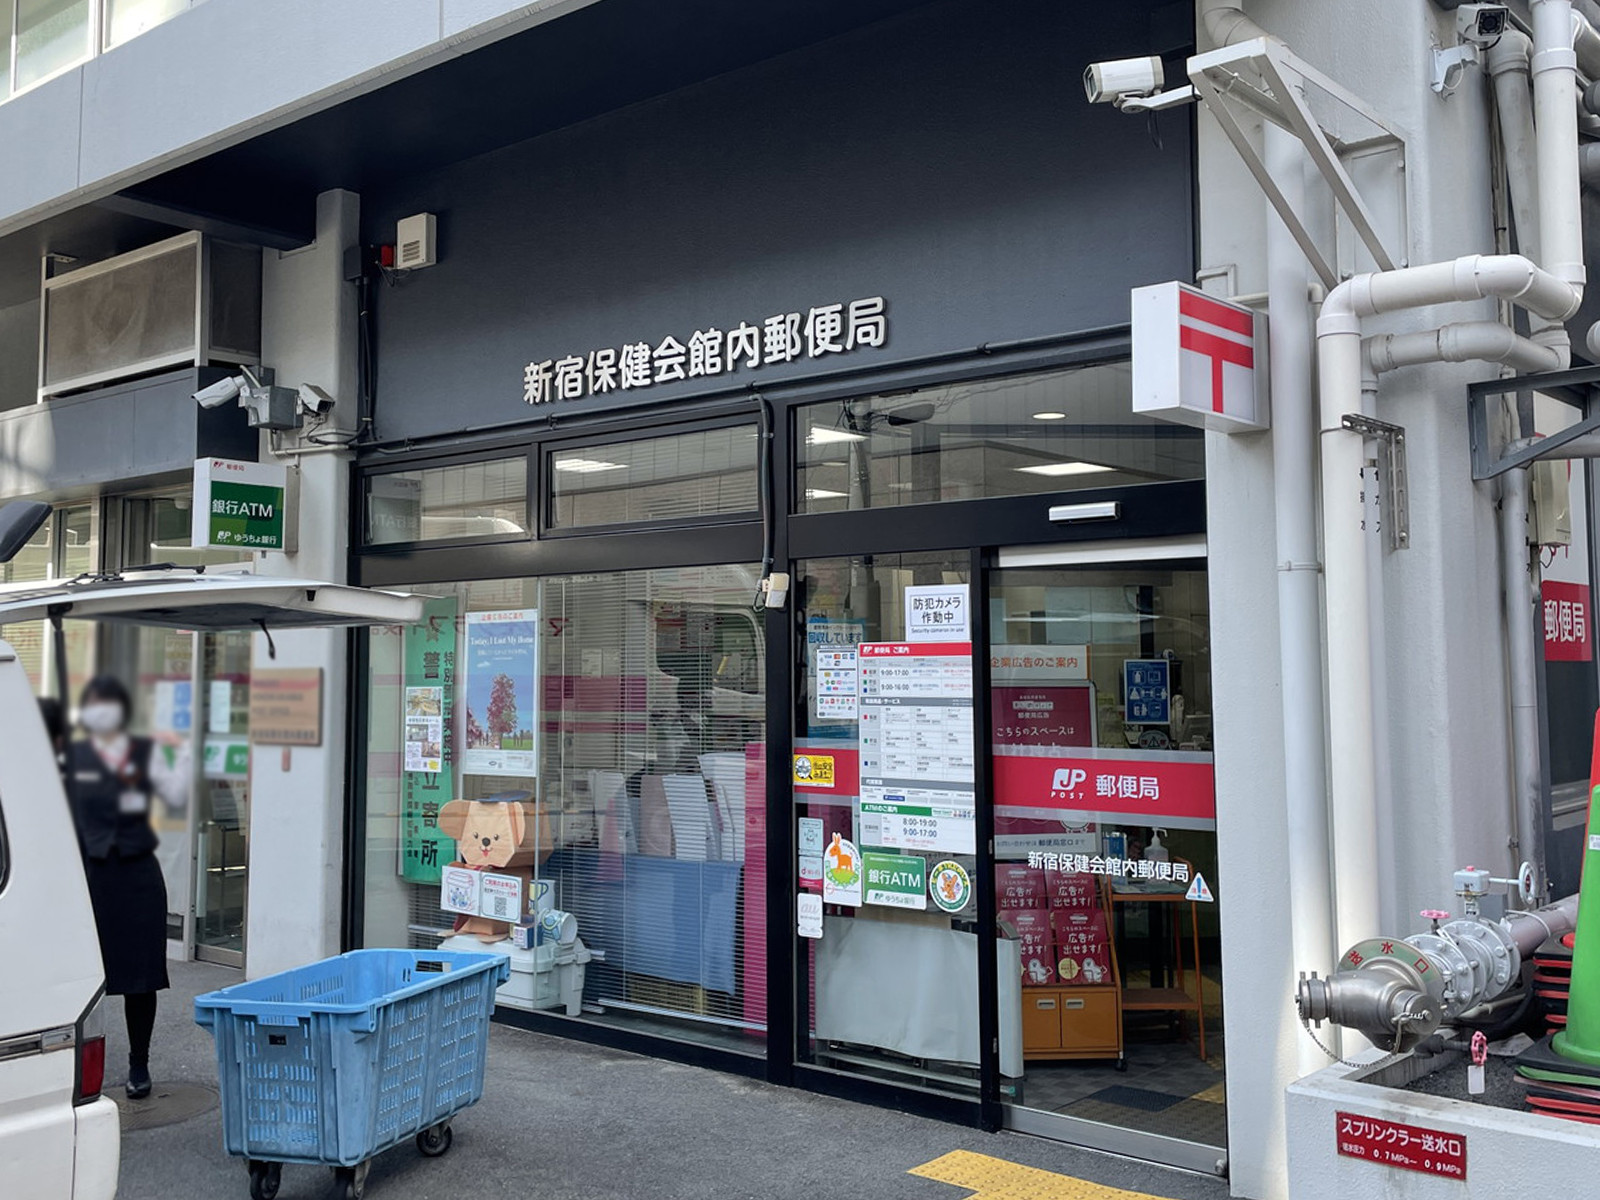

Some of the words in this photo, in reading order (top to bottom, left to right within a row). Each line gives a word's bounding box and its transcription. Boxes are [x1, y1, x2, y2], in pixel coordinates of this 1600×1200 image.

[523, 296, 888, 405] 新宿保健会館内郵便局
[211, 499, 273, 518] 銀行ATM
[233, 534, 278, 545] ゆうちょ銀行
[913, 596, 961, 610] 防犯カメラ
[921, 611, 954, 624] 作動中
[1544, 599, 1587, 643] 郵便局
[991, 656, 1078, 668] 企業広告のご案内
[996, 726, 1075, 737] こちらのスペースは
[1095, 774, 1160, 801] 郵便局
[1050, 791, 1085, 800] POST
[903, 818, 938, 828] 8:00-19:00
[903, 828, 938, 838] 9:00-17:00
[1027, 851, 1190, 883] 新宿保健会館内郵便局
[868, 869, 921, 888] 銀行ATM
[1058, 886, 1085, 896] 広告が
[1068, 933, 1095, 944] 広告が
[1342, 1118, 1461, 1156] スプリンクラー送水口
